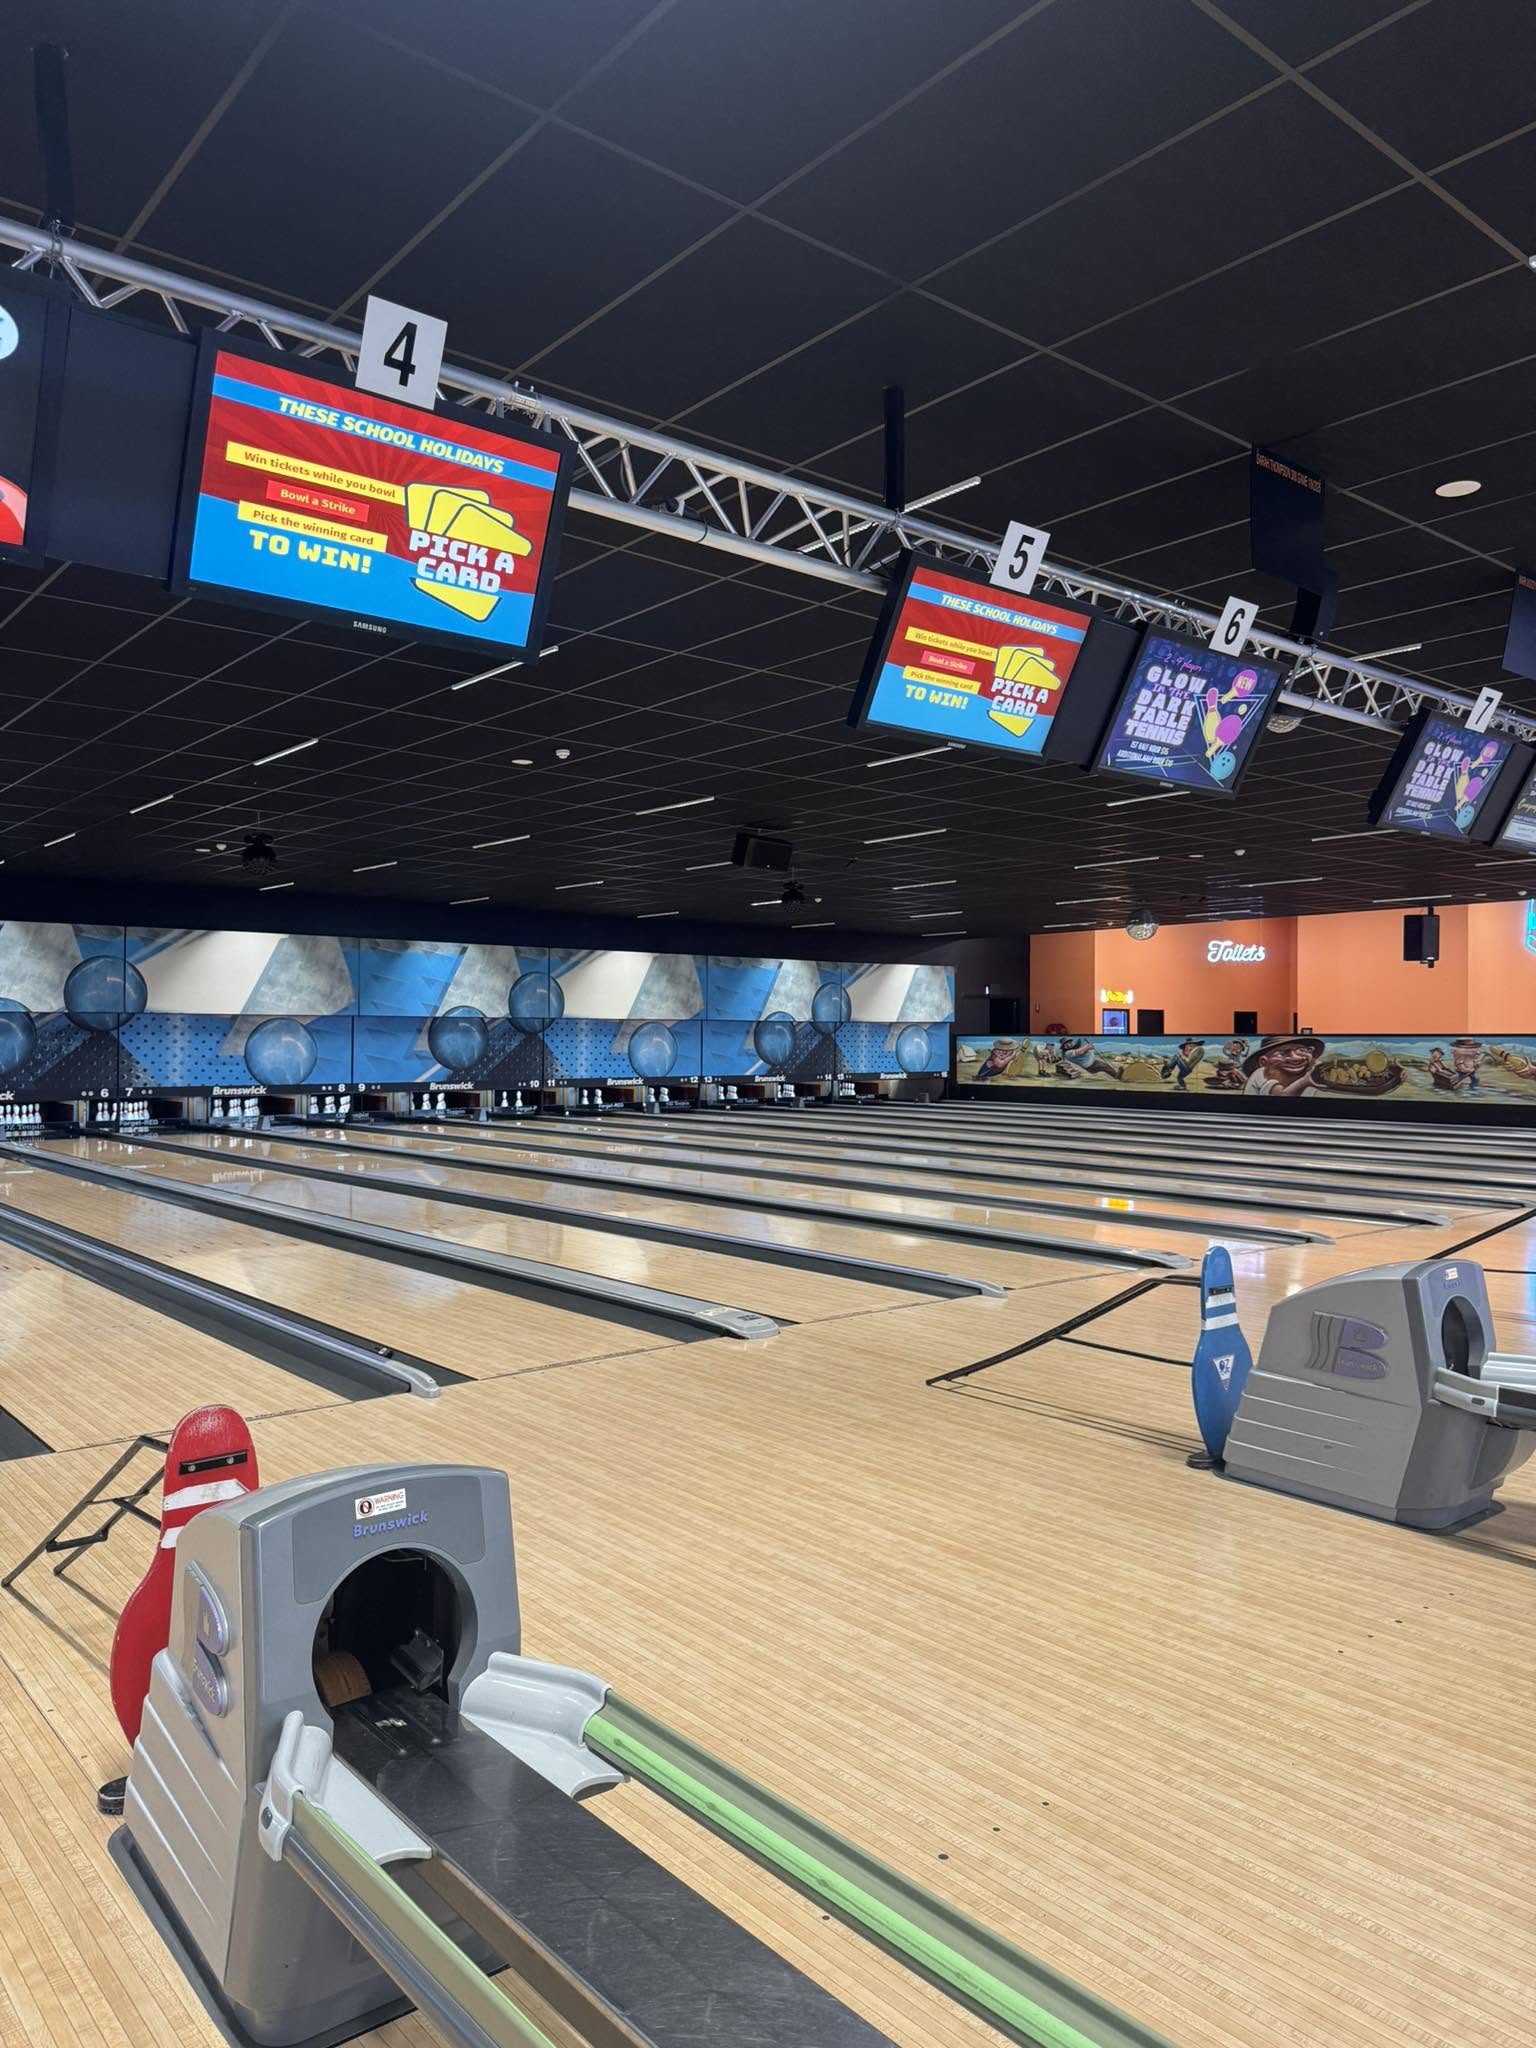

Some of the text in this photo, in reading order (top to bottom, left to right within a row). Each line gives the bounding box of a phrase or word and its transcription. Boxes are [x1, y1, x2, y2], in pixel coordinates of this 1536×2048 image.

[383, 321, 418, 388] 4
[279, 397, 505, 474] THESE SCHOOL HOLIDAYS
[244, 451, 396, 499] Win tickets while you bowl
[280, 488, 356, 515] Bowl a Strike
[253, 509, 374, 546] Pick the winning card
[249, 529, 372, 574] TO WIN!
[408, 529, 515, 575] PICK A
[1008, 534, 1036, 580] 5
[416, 556, 501, 593] CARD
[940, 594, 1058, 635] THESE SCHOOL HOLIDAYS
[353, 620, 388, 634] SAMSUNG
[1224, 607, 1246, 646] 6
[928, 635, 948, 646] tickets
[950, 640, 964, 650] while
[910, 671, 924, 680] Pick
[925, 674, 935, 683] the
[935, 677, 959, 689] winning
[1147, 665, 1207, 693] GLOW
[1236, 676, 1256, 691] NEW
[905, 684, 969, 709] TO WIN!
[990, 678, 1049, 704] PICK A
[1136, 688, 1196, 717] DARK
[1169, 687, 1192, 699] THE
[991, 695, 1038, 718] CARD
[1133, 703, 1191, 731] TABLE
[1475, 696, 1494, 725] 7
[1125, 719, 1186, 746] TENNIS
[1424, 741, 1464, 762] GLOW
[1411, 771, 1449, 791] TABLE
[1415, 759, 1455, 780] DARK
[1207, 940, 1266, 963] Toilets
[338, 1083, 346, 1092] 8
[358, 1083, 366, 1092] 9
[430, 1081, 474, 1090] Brunswick
[529, 1080, 540, 1088] 10
[547, 1079, 556, 1087] 11
[607, 1077, 644, 1086] Brunswick
[754, 1074, 786, 1082] Brunswick
[100, 1088, 108, 1097] 6
[125, 1088, 133, 1097] 7
[212, 1085, 267, 1096] Brunswick
[374, 1491, 404, 1504] WARNING
[353, 1510, 428, 1537] Brunswick
